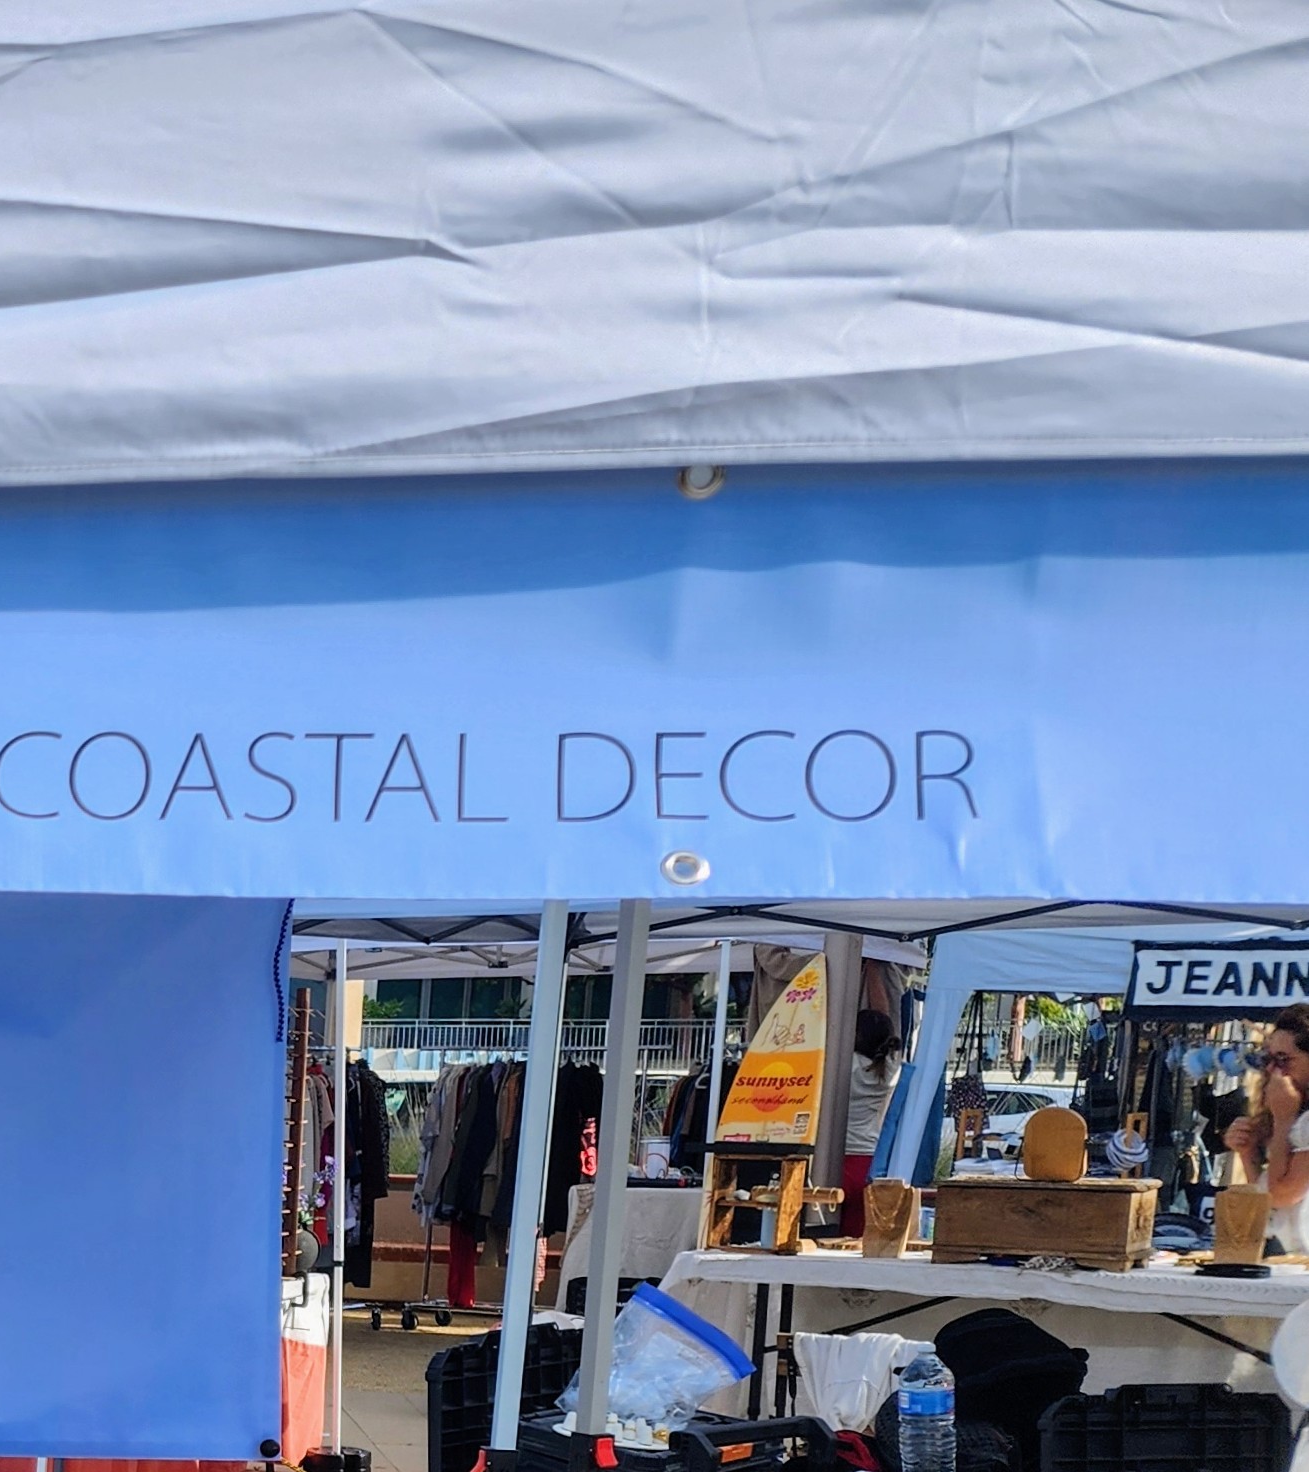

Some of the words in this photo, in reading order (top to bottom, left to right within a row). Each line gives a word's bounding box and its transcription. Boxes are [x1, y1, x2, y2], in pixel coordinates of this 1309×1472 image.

[556, 729, 978, 823] DECOR
[1146, 960, 1309, 997] JEANN
[735, 1074, 813, 1090] sunnyset
